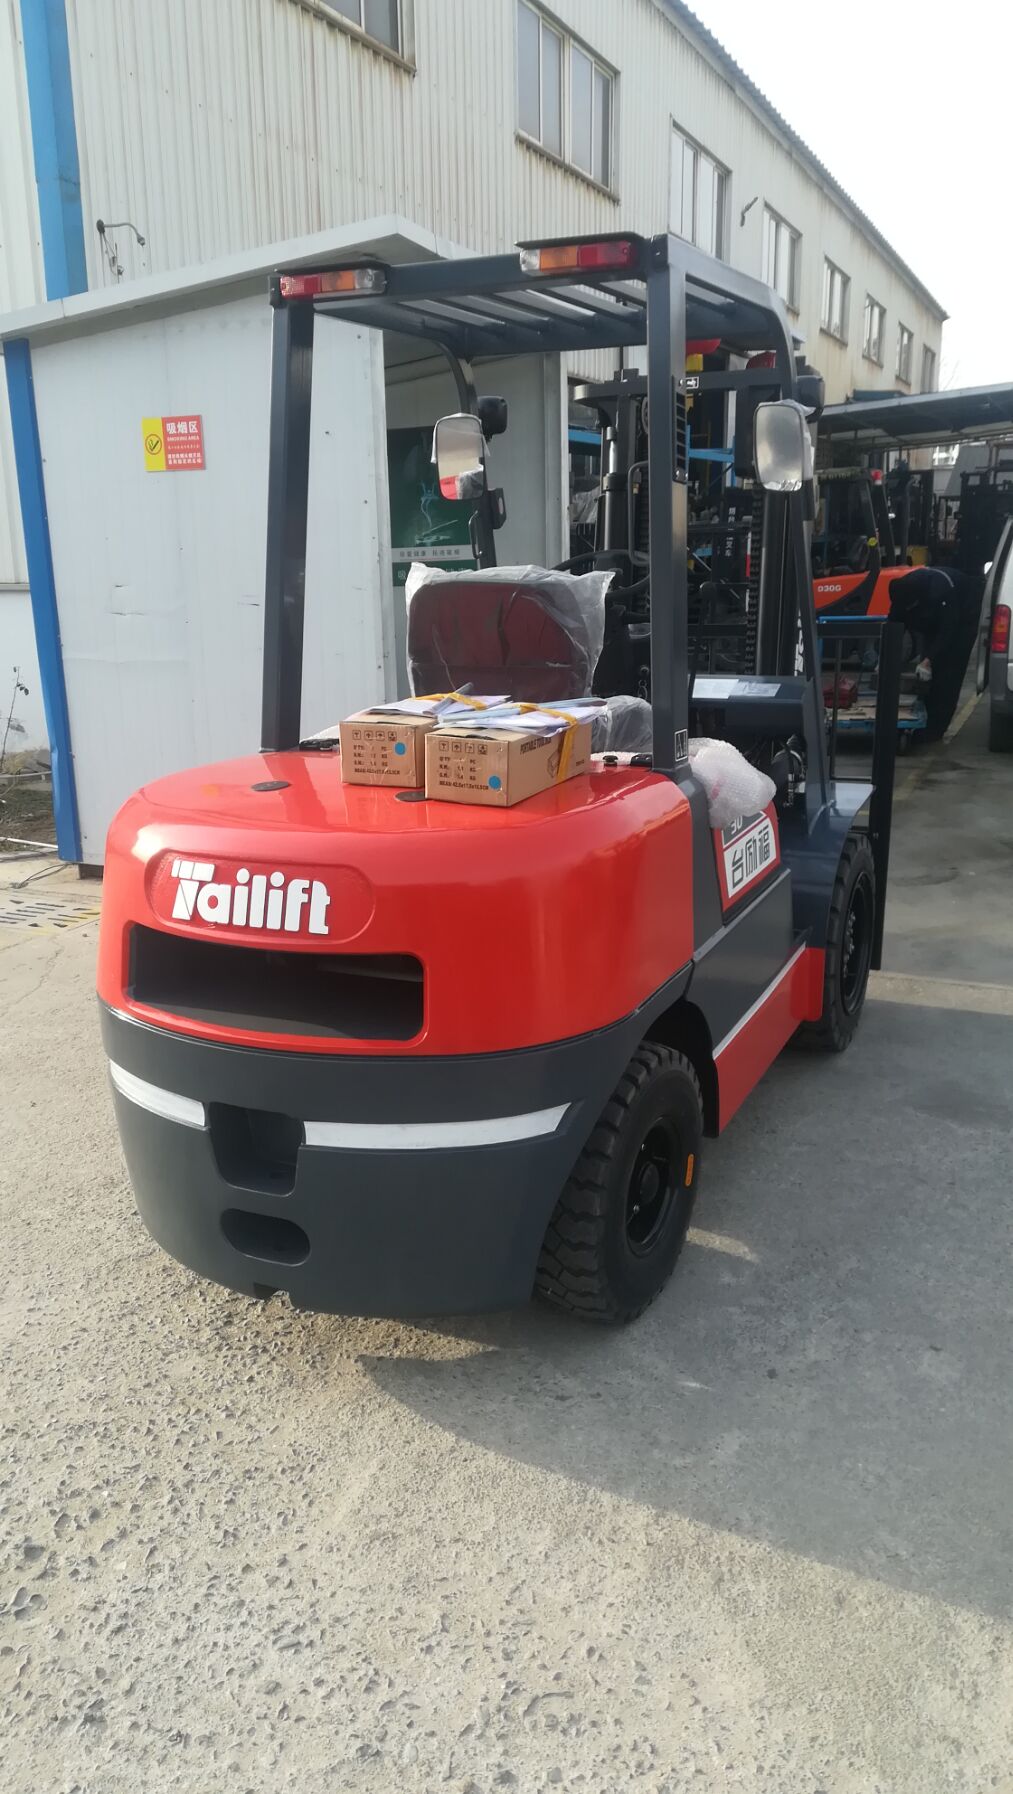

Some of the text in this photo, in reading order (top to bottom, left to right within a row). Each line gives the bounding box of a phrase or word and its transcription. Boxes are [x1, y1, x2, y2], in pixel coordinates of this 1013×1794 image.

[166, 421, 198, 434] 吸烟区
[731, 824, 771, 889] 台励福
[171, 858, 331, 935] Tailift
